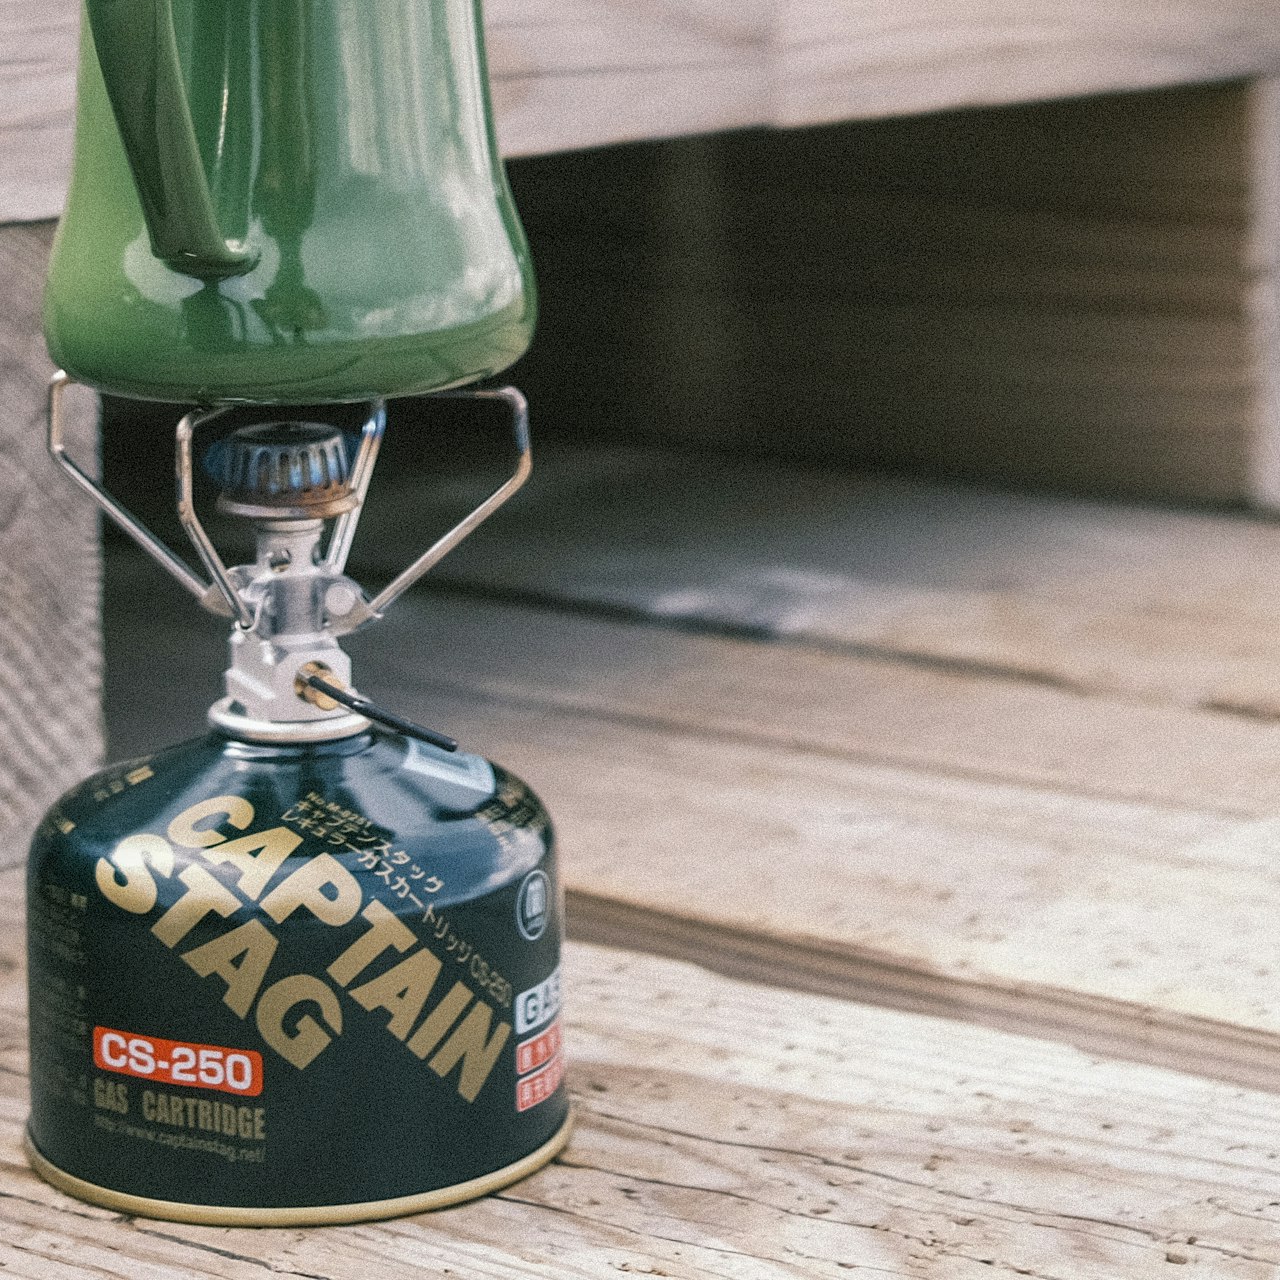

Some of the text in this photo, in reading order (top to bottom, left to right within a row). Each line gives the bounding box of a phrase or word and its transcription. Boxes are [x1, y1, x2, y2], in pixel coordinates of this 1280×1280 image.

[95, 833, 343, 1071] STAG
[166, 794, 512, 1104] CAPTAIN
[93, 1077, 129, 1115] GAS
[142, 1089, 266, 1140] CARTRIDGE
[101, 1032, 253, 1091] CS-250
